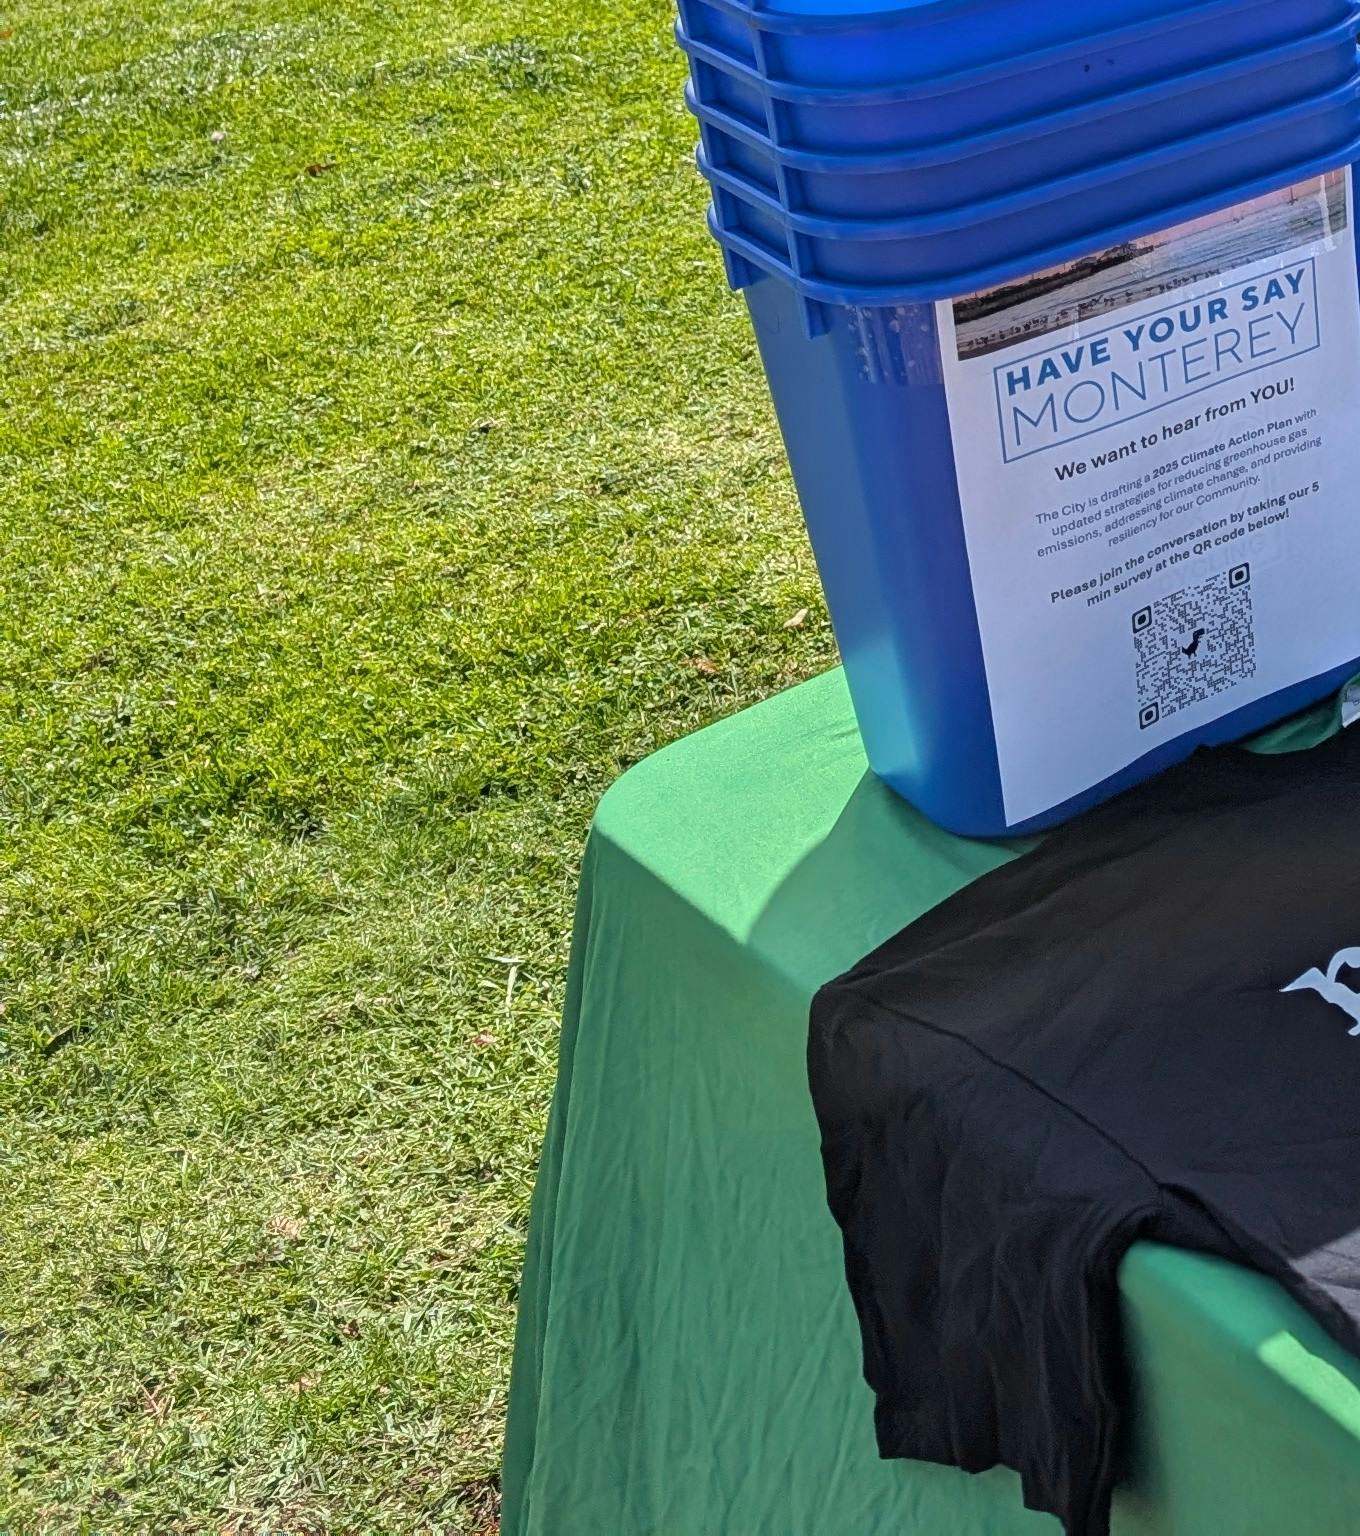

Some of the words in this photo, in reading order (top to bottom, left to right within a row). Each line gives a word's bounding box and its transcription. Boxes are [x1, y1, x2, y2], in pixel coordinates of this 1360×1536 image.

[1005, 336, 1111, 397] HAVE
[1124, 296, 1229, 352] YOUR
[1240, 267, 1305, 312] SAY
[1012, 301, 1305, 447] MONTEREY
[1034, 510, 1059, 524] The
[1060, 501, 1087, 516] City
[1087, 496, 1099, 507] is
[1099, 477, 1143, 503] drafting
[1143, 473, 1151, 484] a
[1151, 459, 1179, 480] 2025
[1180, 442, 1226, 466] Climate
[1227, 427, 1265, 449] Action
[1266, 417, 1293, 433] Plan
[1293, 408, 1317, 424] with
[1050, 509, 1102, 536] updated
[1103, 486, 1156, 517] strategies
[1156, 478, 1172, 492] for
[1173, 458, 1222, 485] reducing
[1222, 434, 1287, 468] greenhouse
[1287, 427, 1308, 443] gas
[1053, 460, 1087, 481] We
[1090, 440, 1138, 469] want
[1139, 433, 1158, 449] to
[1161, 413, 1202, 441] hear
[1203, 397, 1247, 423] from
[1249, 376, 1295, 404] YOU!
[1036, 528, 1103, 558] emissions,
[1103, 497, 1163, 533] addressing
[1162, 480, 1204, 505] climate
[1205, 464, 1249, 487] change,
[1249, 452, 1271, 470] and
[1272, 435, 1322, 463] providing
[1050, 577, 1097, 604] Please
[1098, 565, 1123, 586] join
[1124, 554, 1145, 571] the
[1146, 517, 1228, 559] conversation
[1229, 510, 1245, 524] by
[1245, 493, 1287, 516] taking
[1287, 485, 1310, 501] our
[1311, 480, 1320, 493] 5
[1107, 515, 1158, 548] resiliency
[1158, 507, 1174, 522] for
[1174, 499, 1194, 514] our
[1195, 474, 1261, 506] Community.
[1086, 584, 1111, 607] min
[1113, 566, 1153, 594] survey
[1154, 558, 1167, 573] at
[1168, 549, 1190, 565] the
[1192, 538, 1213, 556] QR
[1213, 526, 1245, 546] code
[1246, 506, 1290, 533] below!
